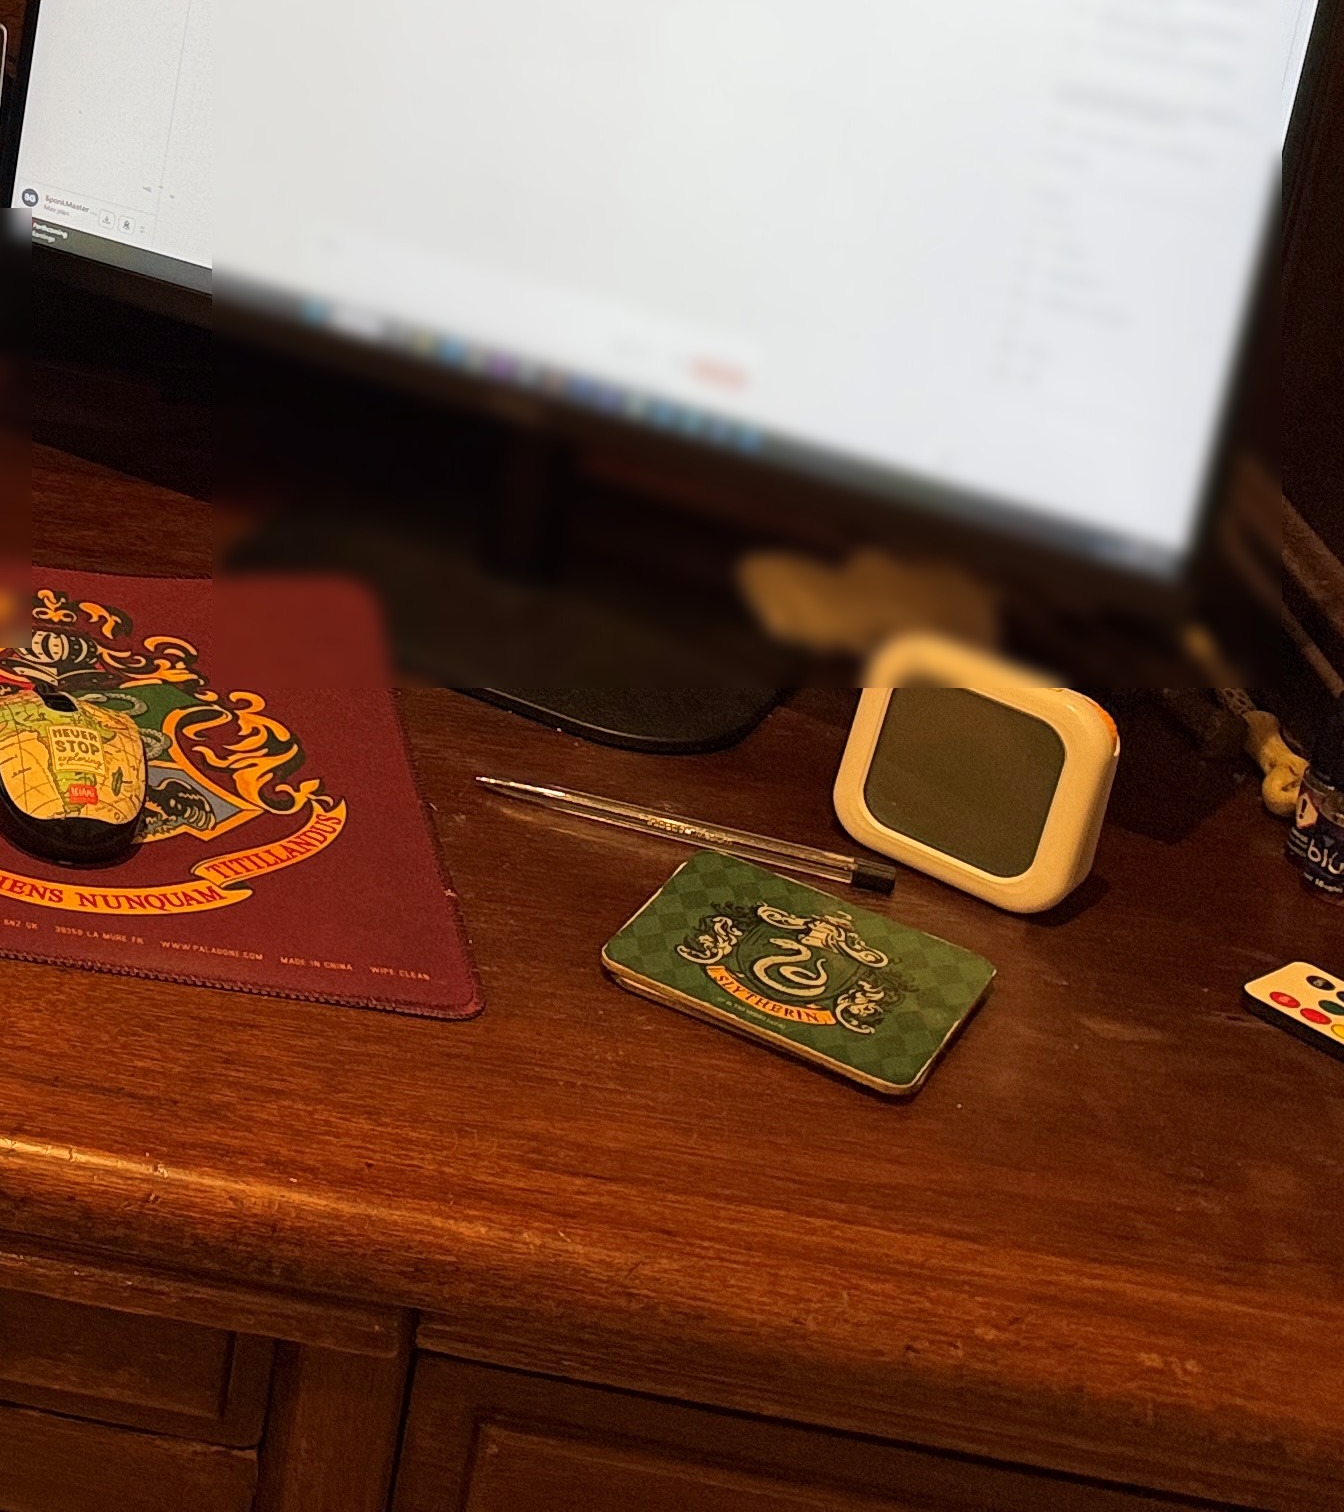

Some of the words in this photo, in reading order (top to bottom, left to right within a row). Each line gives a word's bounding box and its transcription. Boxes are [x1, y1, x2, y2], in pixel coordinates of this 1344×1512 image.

[52, 728, 98, 743] NEVER
[55, 740, 100, 756] STOP
[78, 883, 228, 913] NUNQUAM
[207, 813, 344, 880] TITILLANDUS
[280, 956, 306, 967] MADE
[323, 961, 353, 972] CHINA
[370, 966, 394, 977] WIPE
[399, 969, 430, 982] CLEAN
[716, 973, 820, 1023] SLYTHERIN
